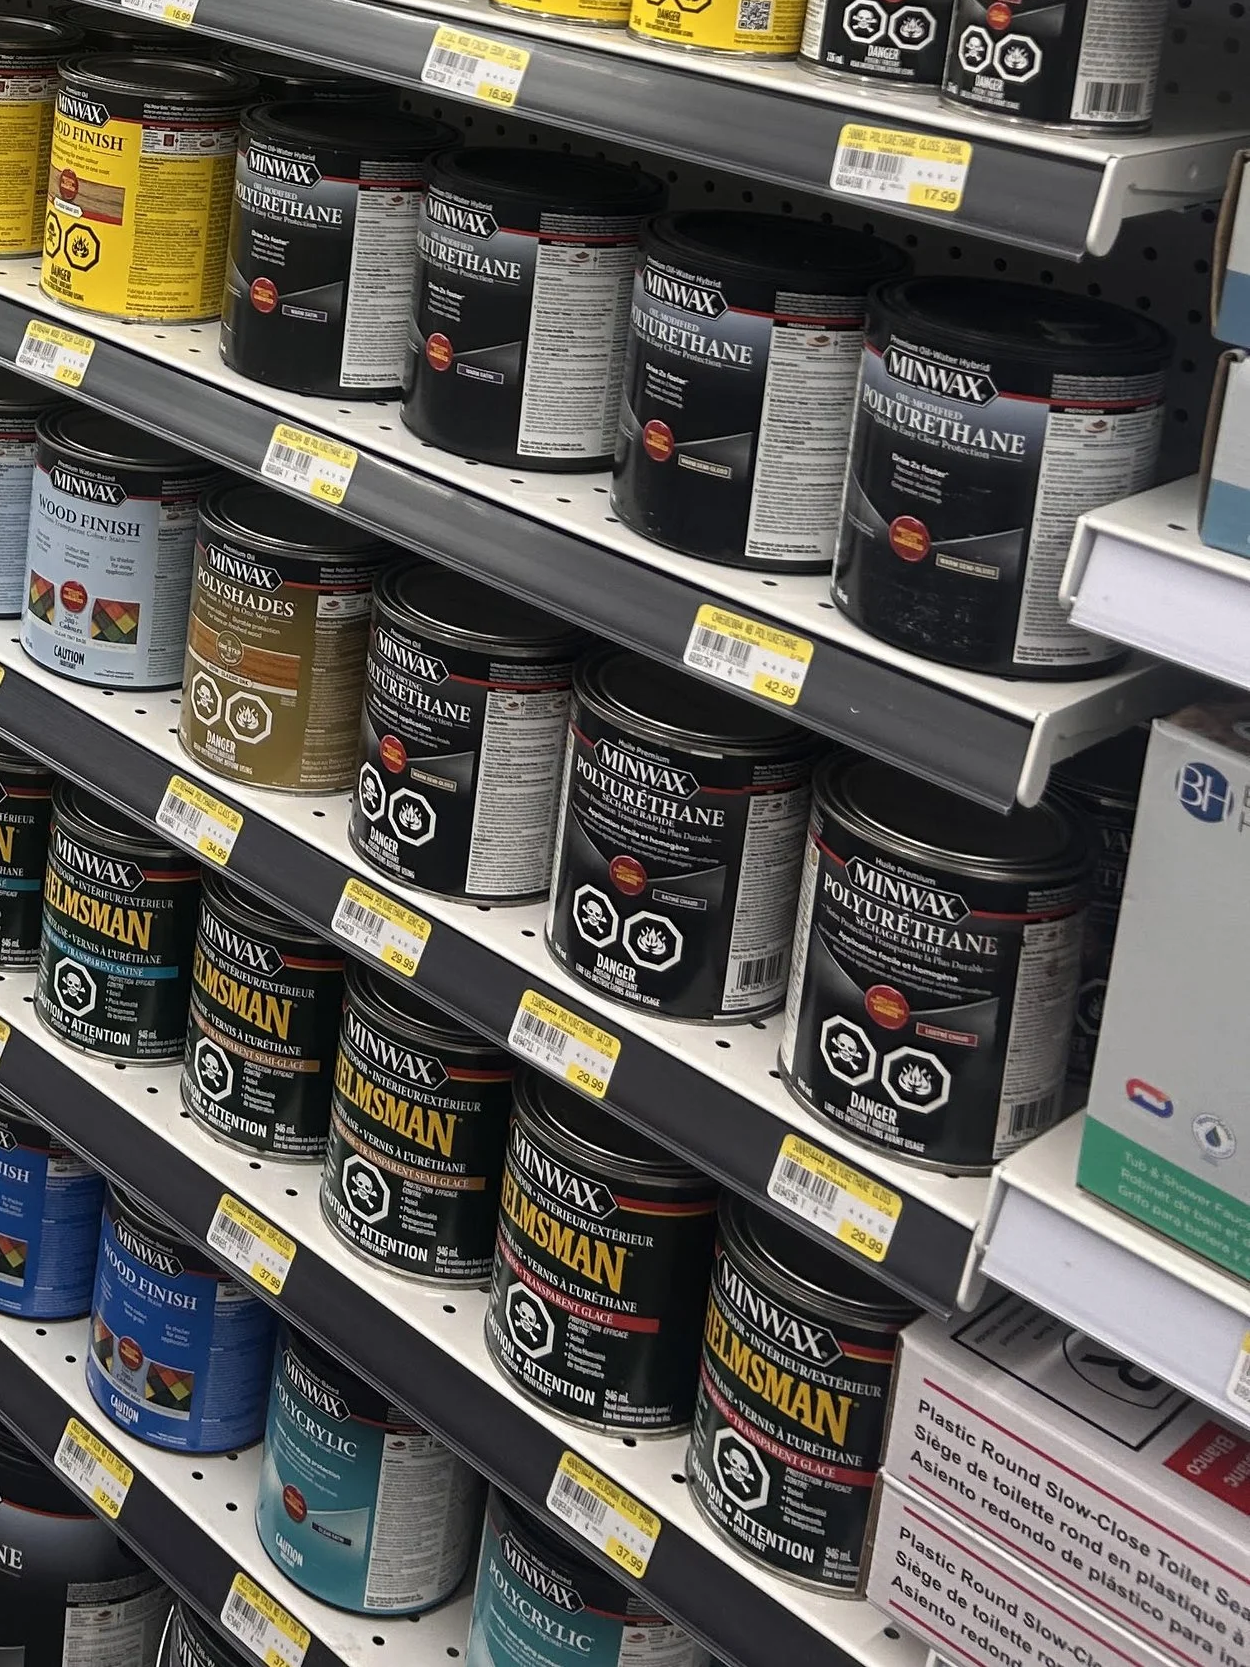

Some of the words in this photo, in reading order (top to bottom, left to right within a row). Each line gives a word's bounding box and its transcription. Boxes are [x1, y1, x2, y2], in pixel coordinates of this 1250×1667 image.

[58, 93, 105, 126] MINWAX
[74, 127, 123, 151] FINISH
[923, 187, 955, 204] 17.99
[889, 351, 983, 402] MINWAX
[920, 344, 958, 364] Oil-Water
[959, 358, 990, 373] Hybrid
[863, 384, 1025, 455] POLYURETHANE
[55, 472, 118, 502] MINWAX
[39, 494, 77, 526] WOOD
[80, 514, 141, 537] FINISH
[210, 546, 273, 588] MINWAX
[199, 566, 294, 617] POLYSHADES
[54, 644, 84, 667] CAUTION
[764, 679, 796, 699] 42.99
[206, 729, 236, 754] DANGER
[642, 744, 669, 764] Premium
[577, 755, 724, 828] POLYURÉTHANE
[1176, 766, 1231, 816] BH
[824, 872, 997, 956] POLYURÉTHANE
[855, 916, 898, 942] SÉCHAGE
[901, 936, 941, 955] RAPIDE
[597, 953, 636, 982] DANGER
[577, 1070, 603, 1091] 29.99
[851, 1091, 897, 1126] DANGER
[513, 1128, 600, 1213] MINWAX
[536, 1192, 653, 1248] INTÉRIEUR/EXTÉRIEUR
[259, 1269, 281, 1291] 37.99
[527, 1256, 559, 1285] VERNIS
[522, 1270, 580, 1314] TRANSPARENT
[581, 1304, 613, 1324] GLACÉ
[524, 1356, 595, 1406] ATTENTION
[275, 1374, 358, 1458] POLYCRYLIC
[918, 1398, 976, 1447] Plastic
[981, 1434, 1040, 1488] Round
[1046, 1471, 1151, 1558] Slow-Close
[1156, 1549, 1211, 1595] Toilet
[910, 1448, 976, 1501] Asiento
[981, 1497, 1056, 1553] redondo
[1061, 1544, 1084, 1570] de
[1088, 1557, 1164, 1622] plástico
[914, 1424, 962, 1463] Siège
[967, 1460, 988, 1482] de
[992, 1473, 1054, 1526] toilette
[1059, 1517, 1102, 1556] rond
[1108, 1548, 1131, 1575] en
[1136, 1564, 1226, 1635] plastique
[899, 1526, 955, 1576] Plastic
